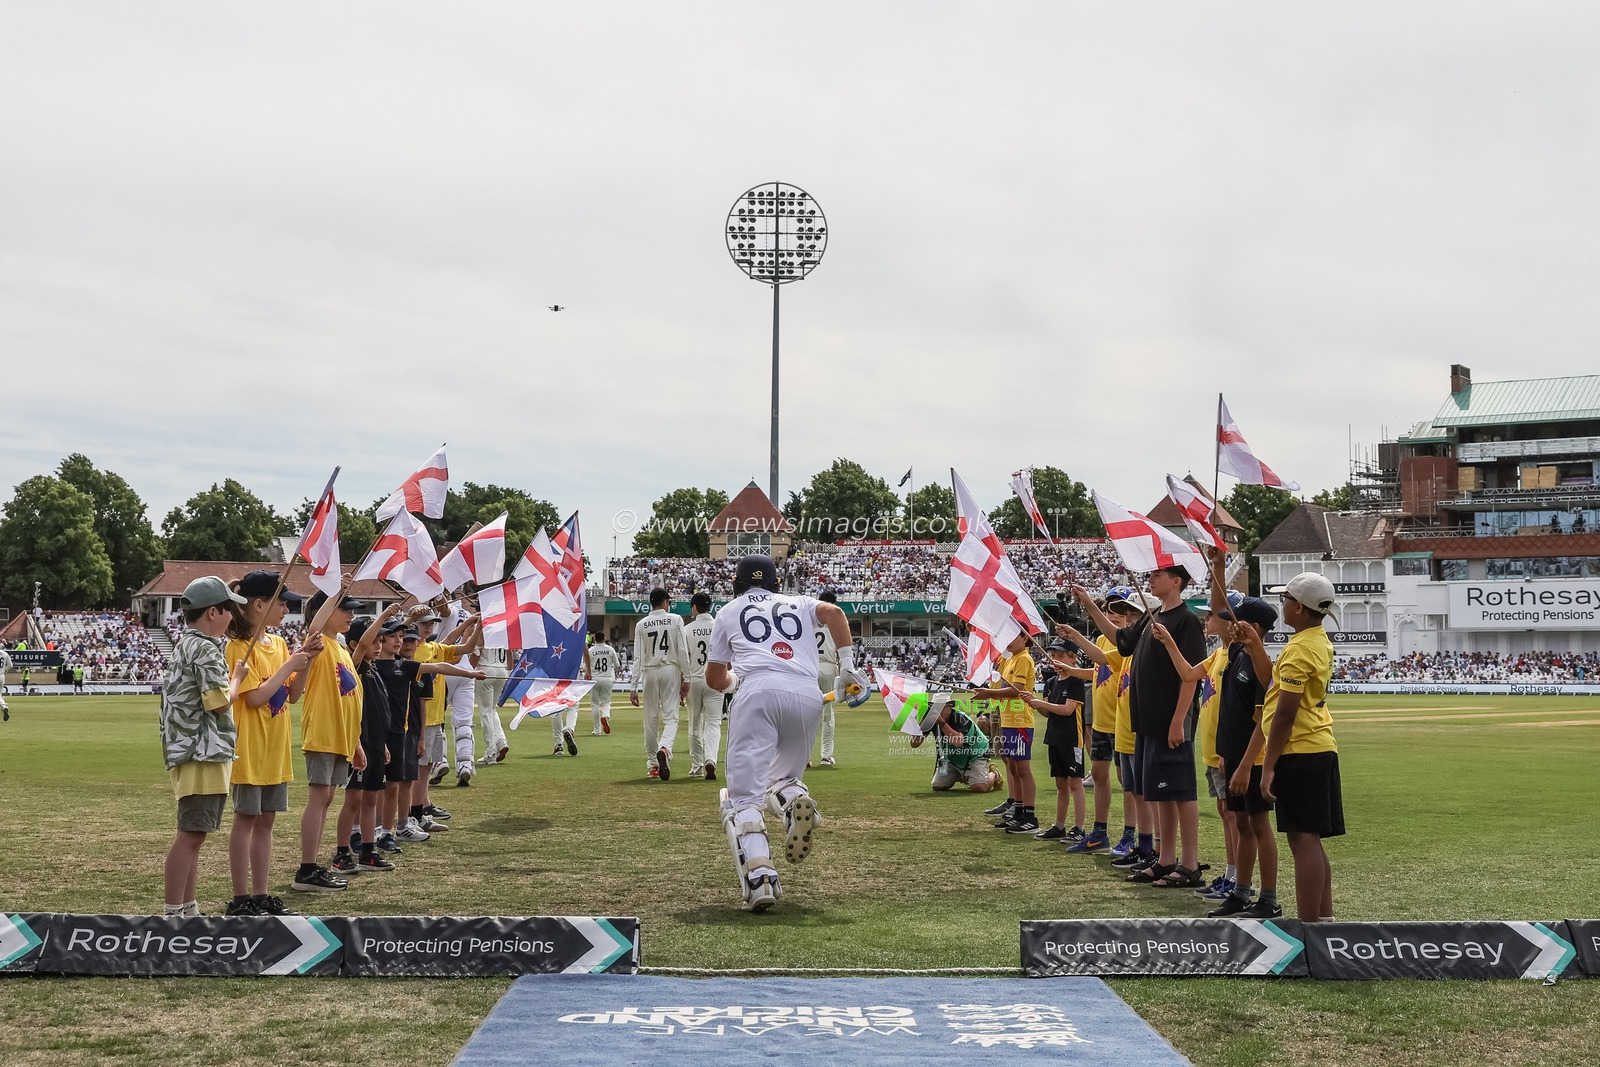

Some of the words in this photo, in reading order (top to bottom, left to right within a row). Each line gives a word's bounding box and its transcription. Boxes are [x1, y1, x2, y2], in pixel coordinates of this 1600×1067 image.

[1337, 584, 1382, 592] CASTORE
[851, 602, 889, 614] Vertu
[923, 602, 946, 613] Ver
[740, 602, 802, 643] 66
[1482, 610, 1540, 623] Protecting
[1543, 609, 1594, 620] Pensions
[643, 618, 672, 629] SANTNER
[647, 629, 669, 657] 74
[1348, 633, 1377, 641] TOYOTA
[772, 645, 793, 656] Vitality
[594, 657, 608, 673] 48
[1400, 685, 1435, 693] Protecting
[1510, 684, 1563, 693] Rothesay
[67, 927, 264, 961] Rothesay
[363, 937, 463, 957] Protecting
[469, 936, 554, 954] Pensions
[1044, 940, 1142, 957] Protecting
[1147, 939, 1230, 954] Pensions
[1325, 937, 1504, 966] Rothesay
[605, 1005, 915, 1017] CRICKET
[557, 1013, 917, 1028] ENGLAND
